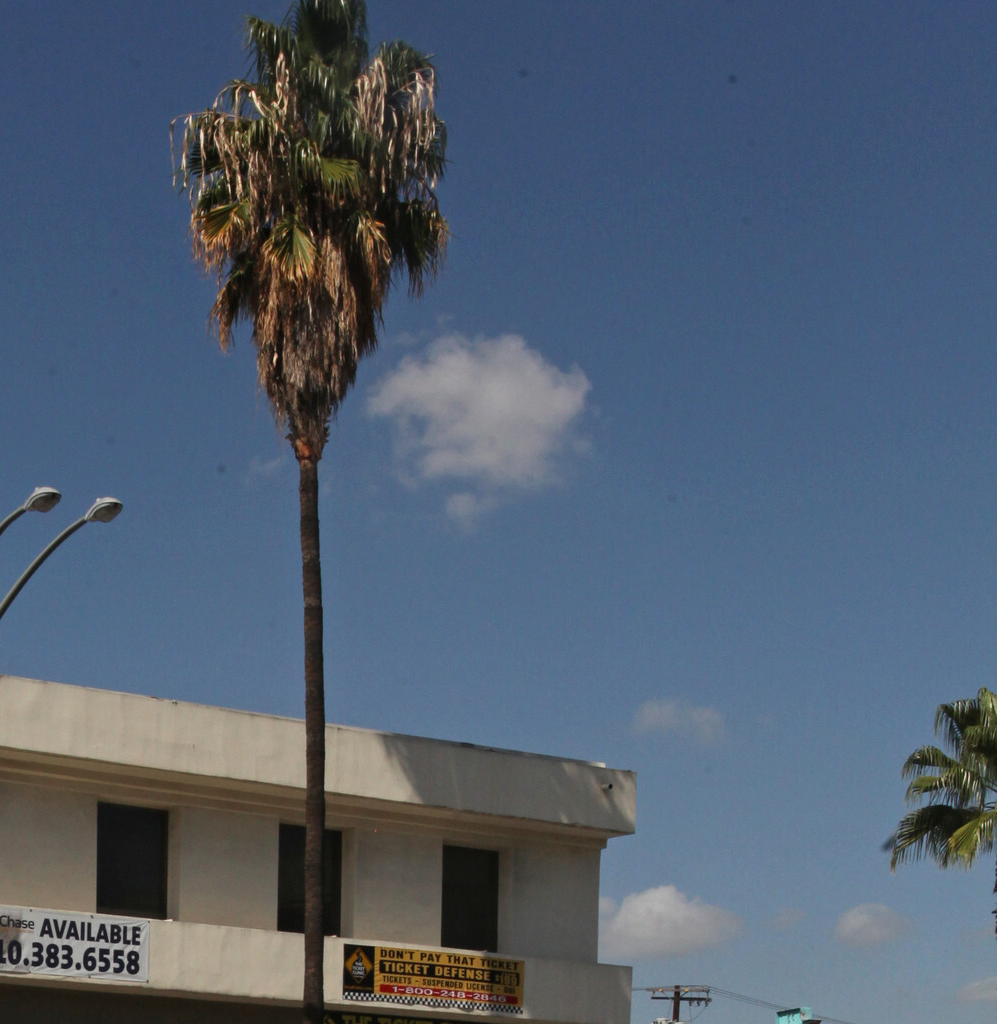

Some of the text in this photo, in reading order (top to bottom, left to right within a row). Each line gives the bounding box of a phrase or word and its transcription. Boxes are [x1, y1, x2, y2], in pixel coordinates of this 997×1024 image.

[40, 918, 141, 946] AVAILABLE
[380, 949, 518, 970] DON'T PAY THAT TICKET
[382, 962, 428, 974] TICKET
[434, 967, 491, 980] DEFENSE
[382, 976, 412, 984] TICKETS
[422, 979, 464, 989] SUSPENDED
[466, 982, 494, 992] LICENSE
[392, 986, 506, 1002] 1-800-248-2846
